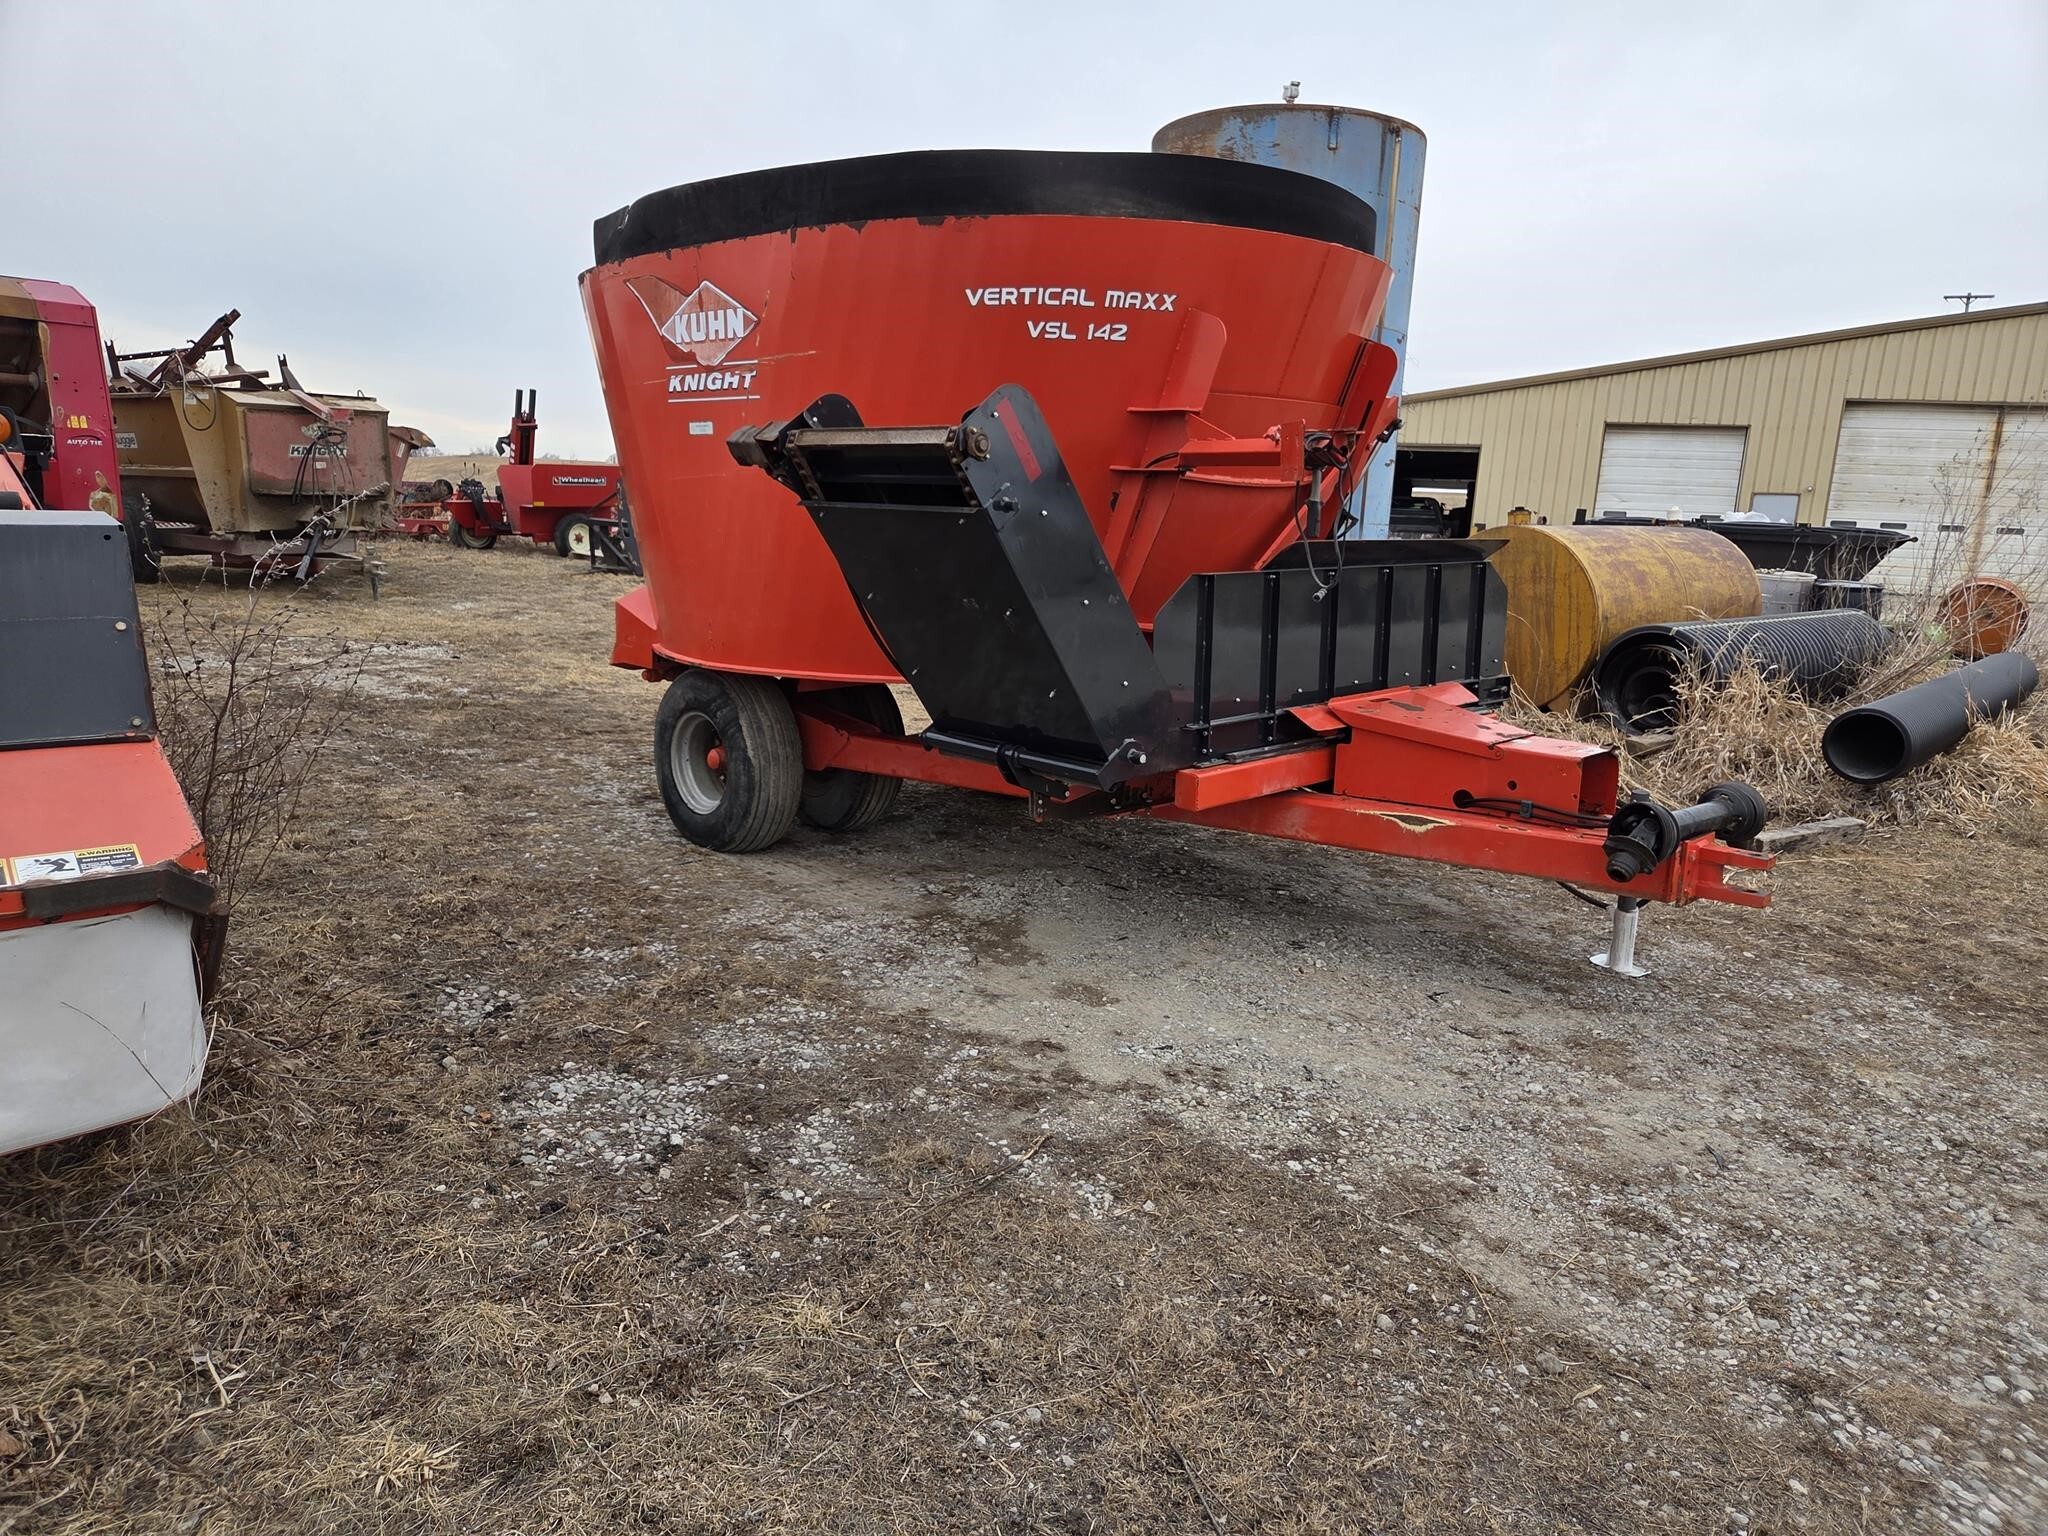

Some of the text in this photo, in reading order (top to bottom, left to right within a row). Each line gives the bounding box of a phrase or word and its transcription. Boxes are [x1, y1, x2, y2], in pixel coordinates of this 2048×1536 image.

[965, 287, 1177, 311] VERTICAL MAXX
[674, 308, 744, 343] KUHN
[1027, 320, 1128, 341] VSL 142
[668, 370, 757, 393] KNIGHT
[117, 434, 136, 448] uggie
[86, 847, 133, 856] WARNING
